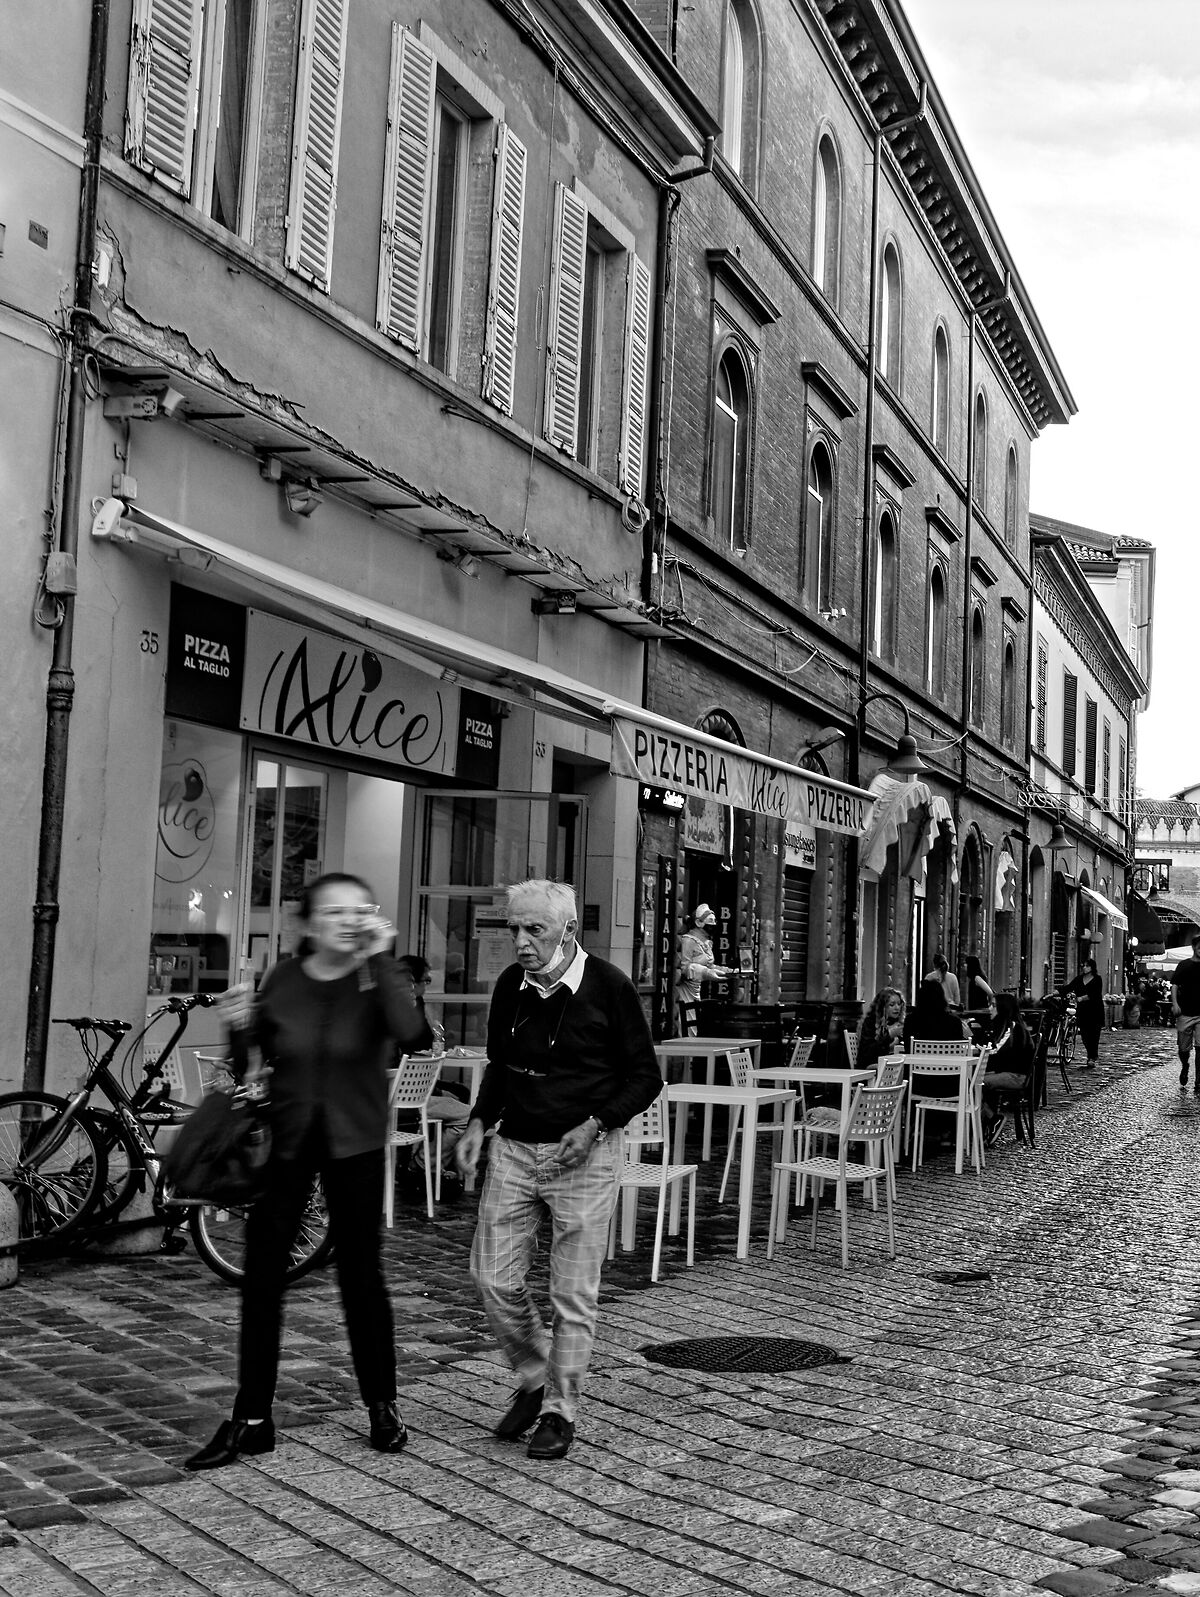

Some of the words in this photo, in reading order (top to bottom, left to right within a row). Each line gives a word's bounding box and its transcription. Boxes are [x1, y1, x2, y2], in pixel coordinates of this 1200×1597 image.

[140, 629, 159, 655] 35
[184, 633, 231, 664] PIZZA
[183, 656, 196, 670] AL
[198, 659, 230, 678] TAGLIO
[274, 636, 443, 766] Alice
[464, 734, 473, 745] AL
[473, 736, 493, 750] TAGLIO
[465, 717, 493, 738] PIZZA
[634, 728, 729, 797] PIZZERIA
[806, 784, 867, 831] PIZZERIA
[163, 781, 210, 841] lice
[659, 878, 672, 1014] PIADINA
[717, 906, 731, 996] BIBIE
